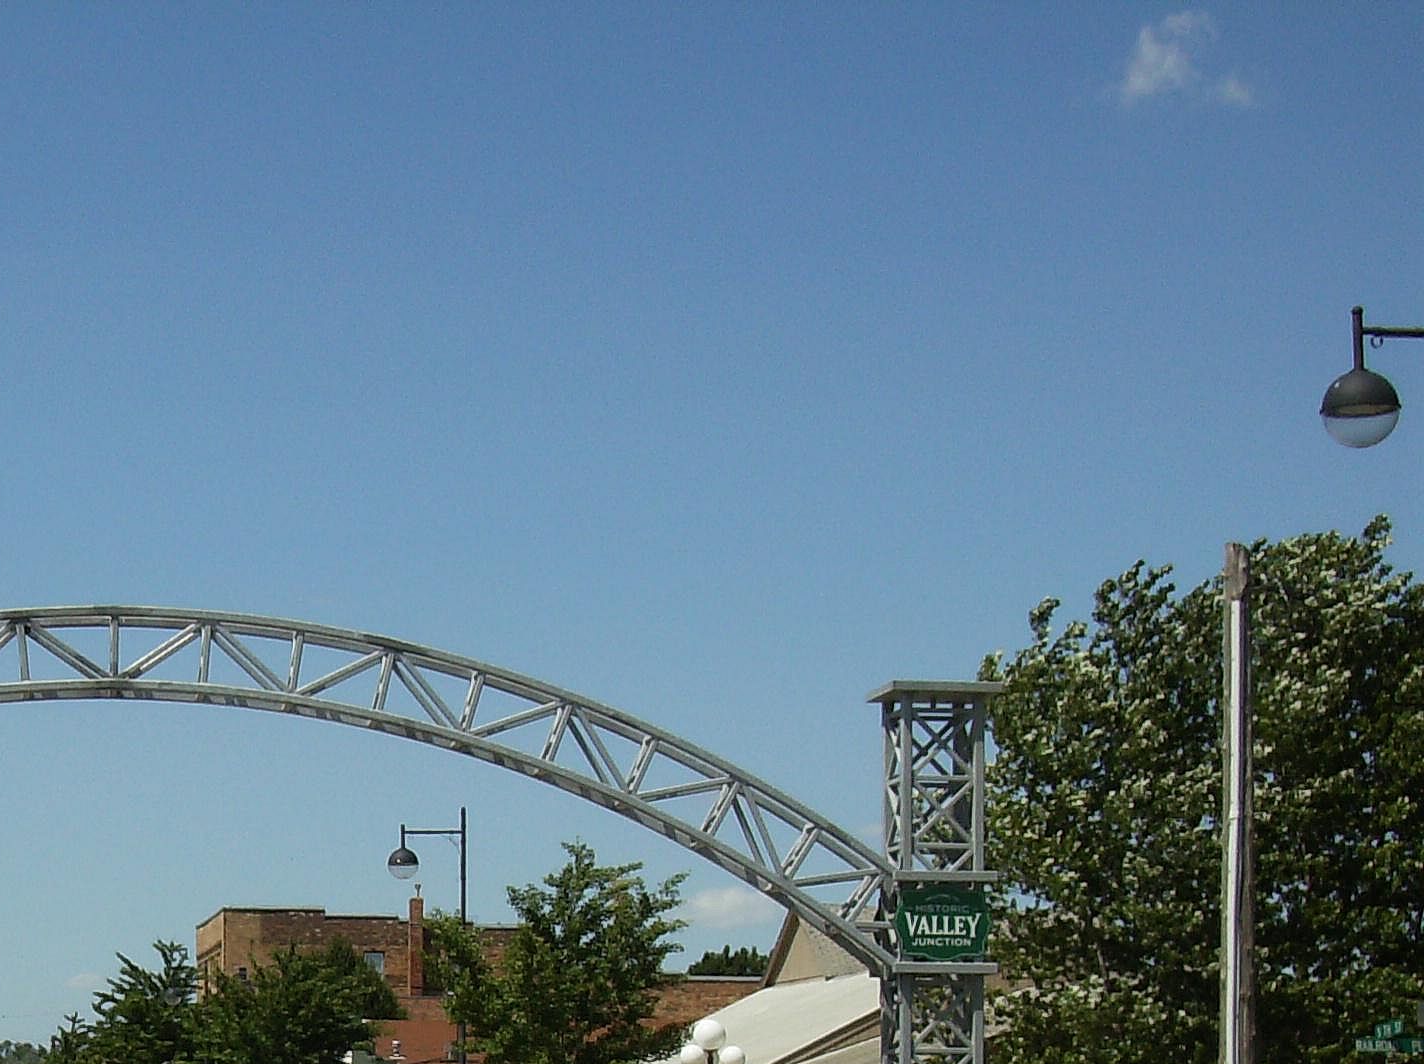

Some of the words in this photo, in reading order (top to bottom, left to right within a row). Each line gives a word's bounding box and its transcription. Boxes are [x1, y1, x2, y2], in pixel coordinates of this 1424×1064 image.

[916, 904, 970, 914] HISTORIC
[904, 912, 982, 938] VALLEY
[912, 938, 972, 947] JUNCTION
